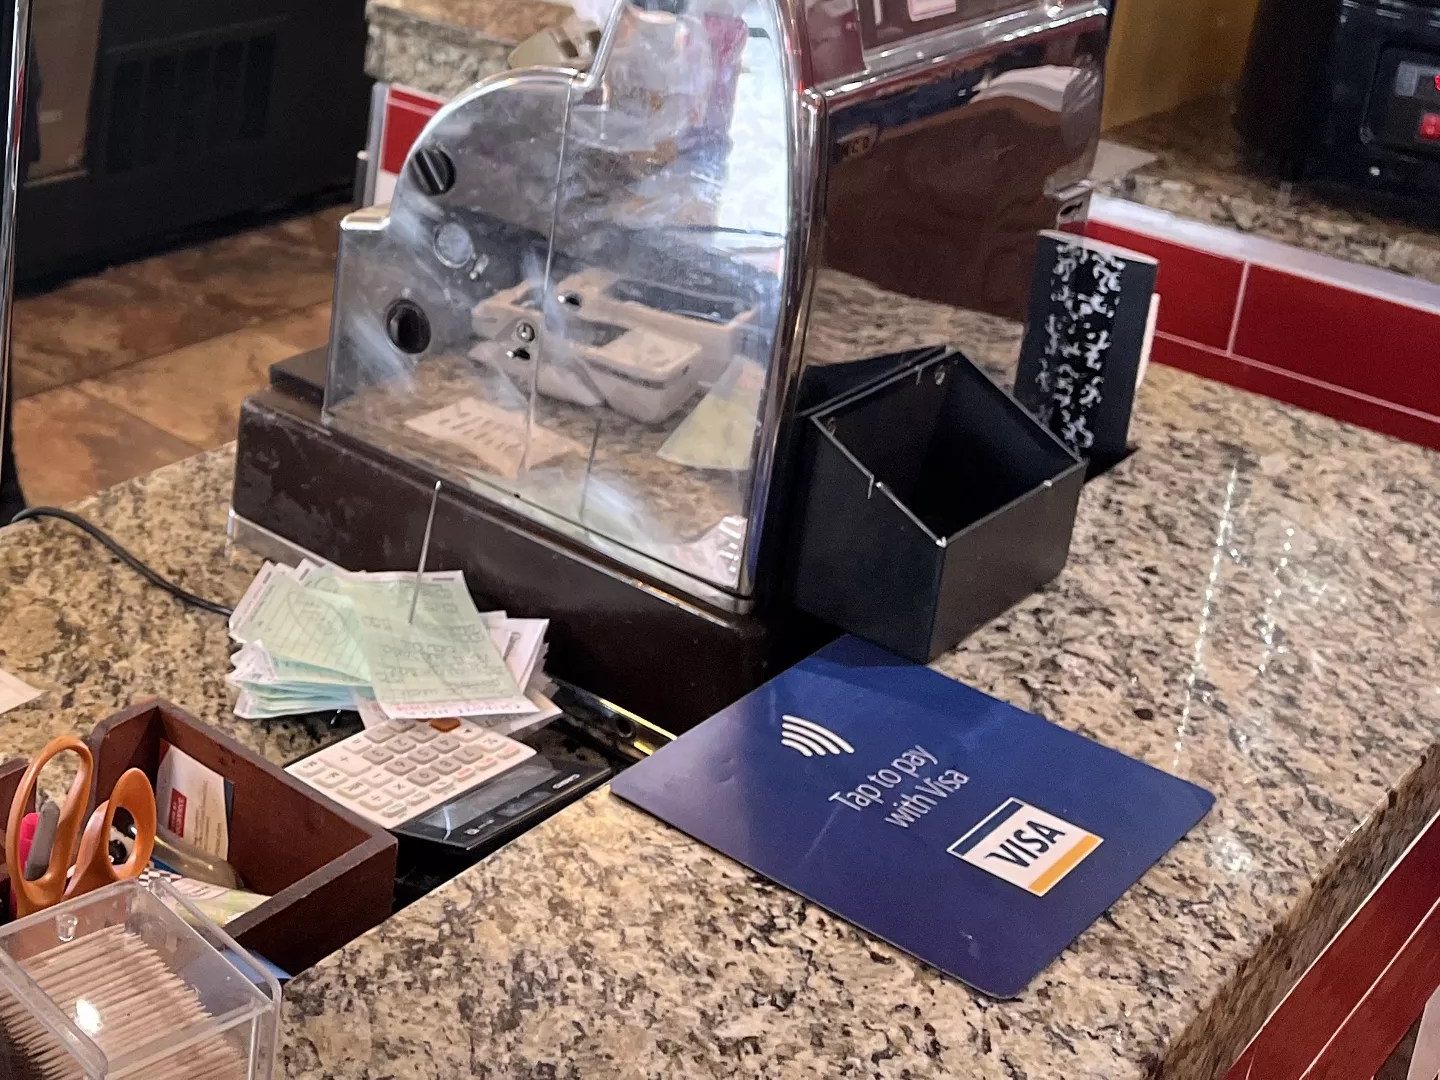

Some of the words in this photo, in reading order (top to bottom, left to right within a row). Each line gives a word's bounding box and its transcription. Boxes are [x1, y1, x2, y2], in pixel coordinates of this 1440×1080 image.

[828, 782, 884, 811] Tap
[867, 768, 902, 789] to
[891, 744, 939, 778] pay
[884, 784, 936, 828] with
[915, 769, 970, 800] Visa
[984, 819, 1067, 868] VISA
